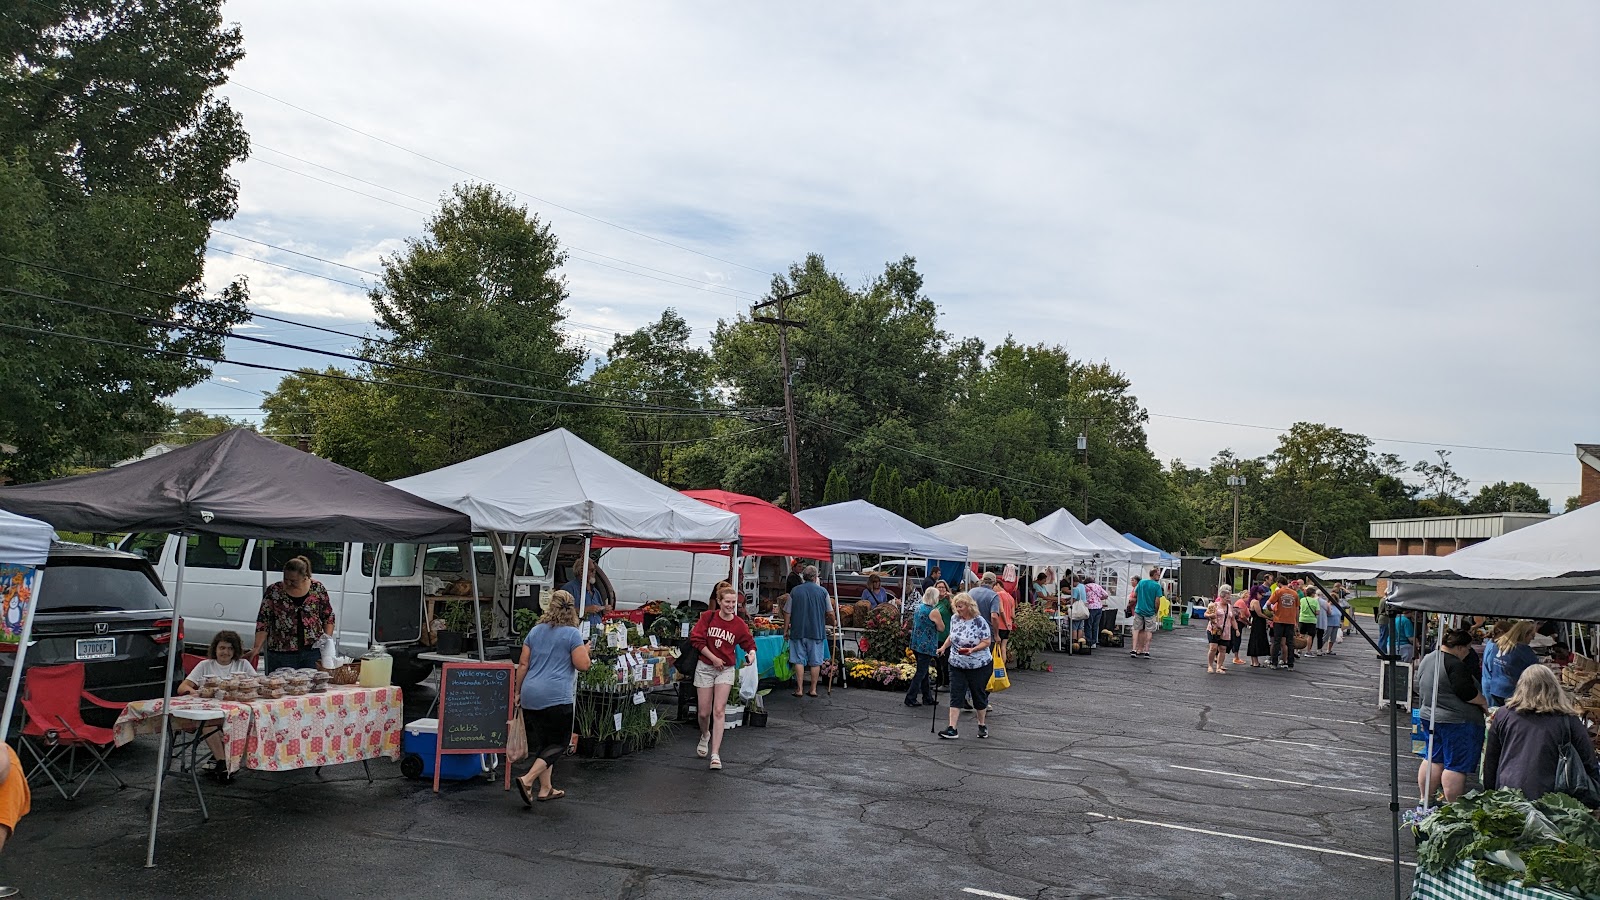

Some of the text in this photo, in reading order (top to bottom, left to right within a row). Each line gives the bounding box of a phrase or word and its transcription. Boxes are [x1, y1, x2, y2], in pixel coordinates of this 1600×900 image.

[707, 627, 735, 645] NDIANA
[448, 724, 479, 733] Caleb's
[450, 733, 486, 742] Lemonade
